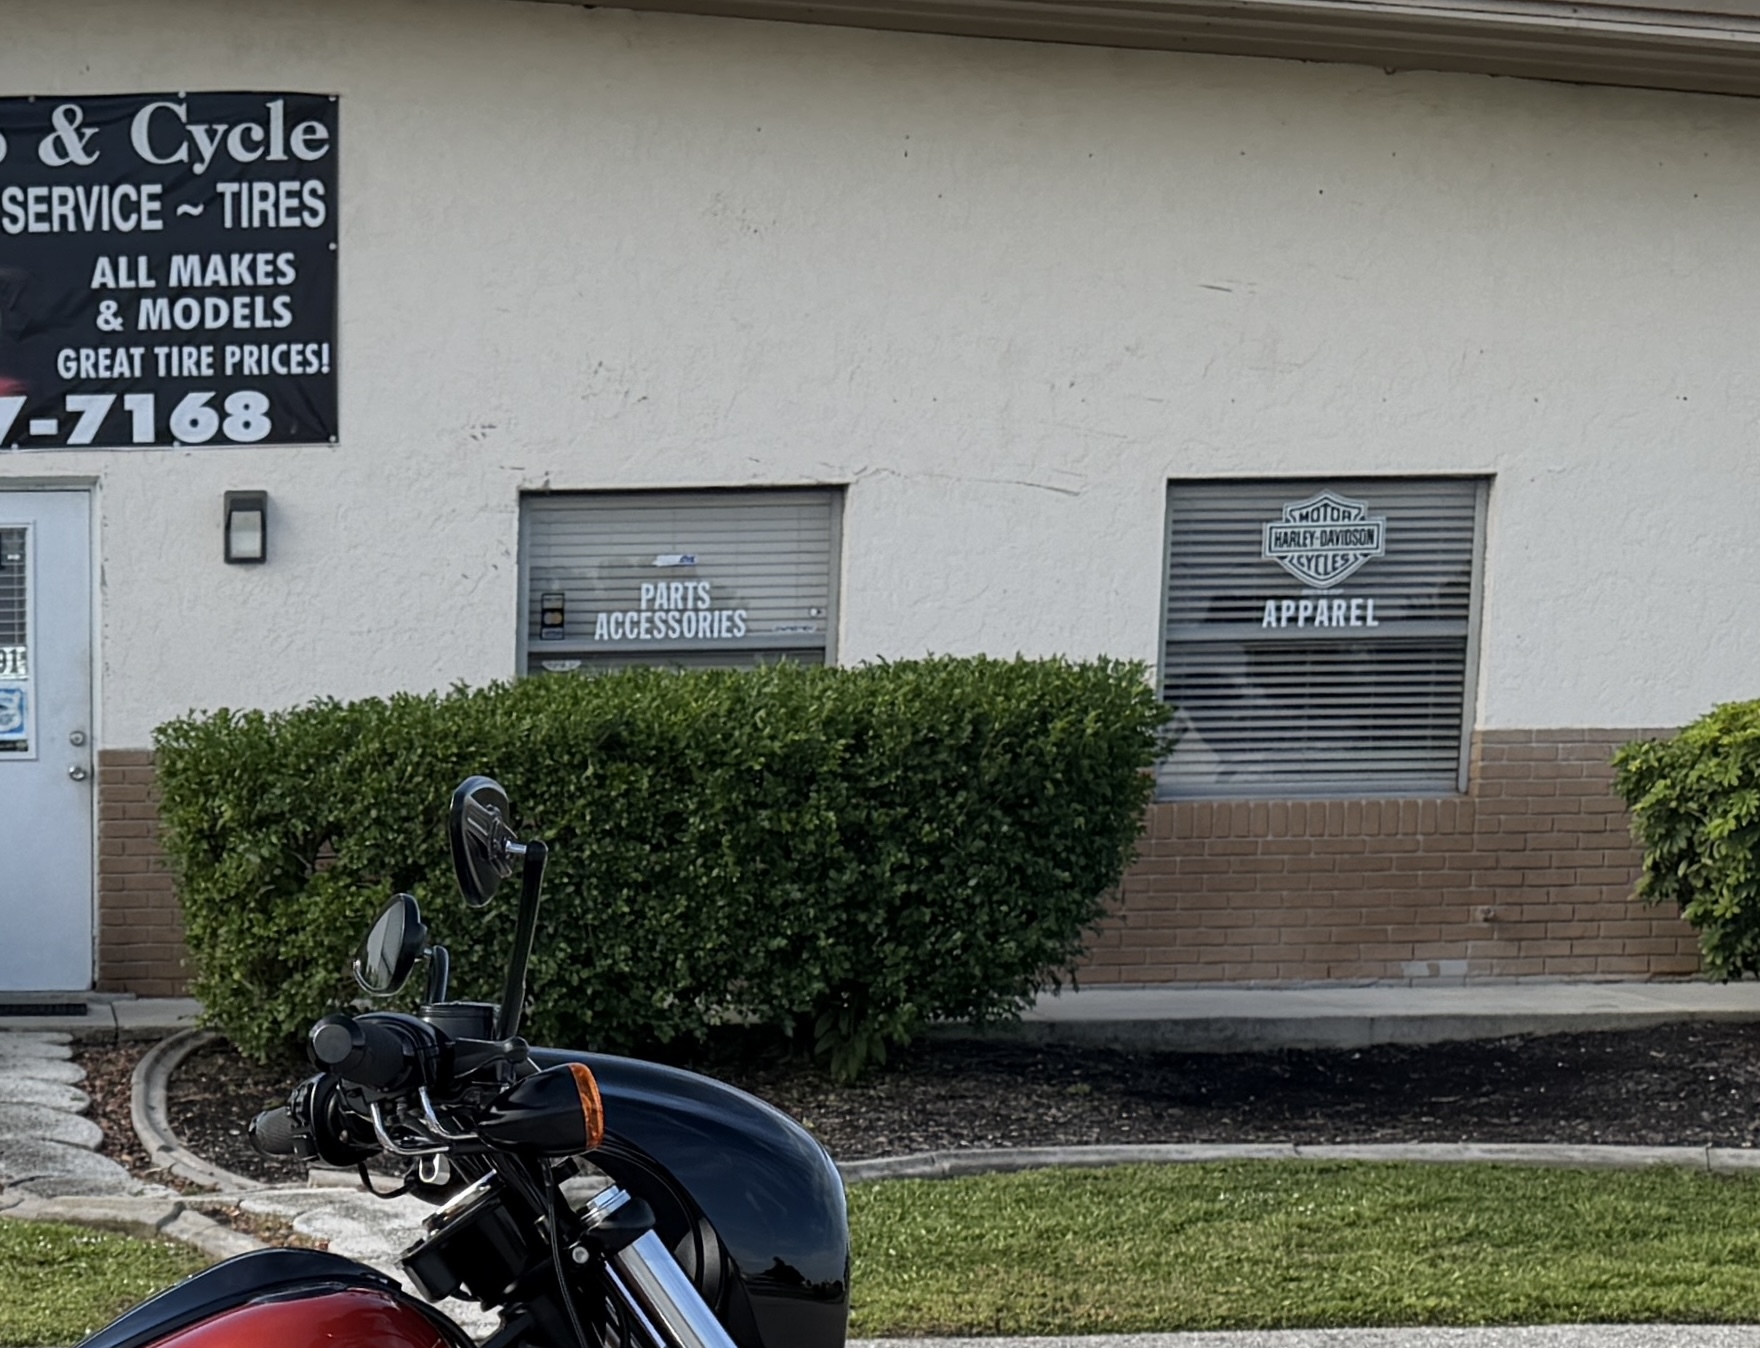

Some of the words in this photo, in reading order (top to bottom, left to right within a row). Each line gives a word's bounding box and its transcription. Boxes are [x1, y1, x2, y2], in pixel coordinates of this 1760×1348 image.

[37, 103, 101, 168] &
[130, 99, 331, 174] Cycle
[1, 184, 163, 234] SERVICE
[216, 179, 328, 229] TIRES
[90, 254, 157, 290] ALL
[168, 252, 297, 288] MAKES
[95, 300, 124, 331] &
[137, 295, 293, 330] MODELS
[56, 347, 146, 380] GREAT
[154, 346, 214, 378] TIRE
[224, 342, 331, 377] PRICES!
[1298, 503, 1352, 523] MOTOR
[1274, 528, 1375, 548] HARLEY-DAVIDSON
[1296, 553, 1350, 576] CYCLES
[640, 580, 712, 611] PARTS
[593, 608, 749, 641] ACCESSORIES
[1261, 597, 1380, 629] APPAREL
